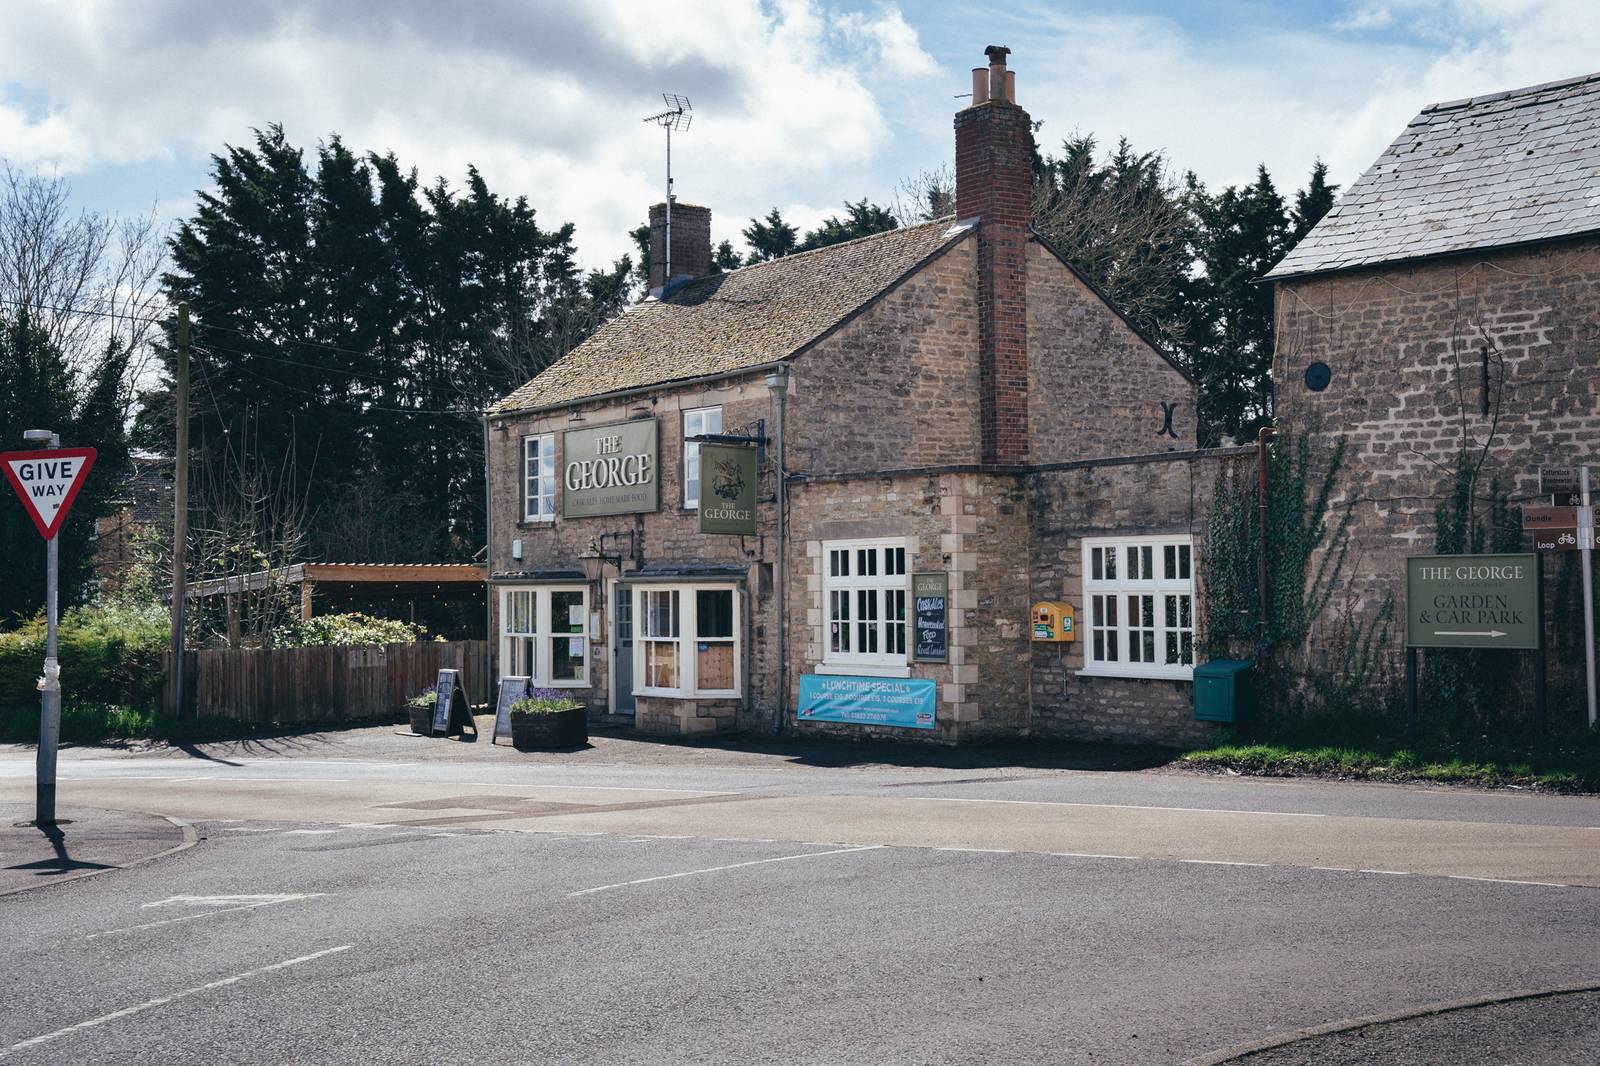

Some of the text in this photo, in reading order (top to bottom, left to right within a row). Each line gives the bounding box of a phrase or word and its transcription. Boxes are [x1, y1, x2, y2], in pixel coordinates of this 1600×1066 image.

[595, 435, 621, 454] THE
[20, 461, 73, 481] GIVE
[565, 454, 650, 491] GEORGE
[32, 484, 65, 497] WAY
[704, 508, 751, 520] GEORGE
[1537, 541, 1556, 550] Loop
[1420, 566, 1524, 580] THE GEORGE
[917, 583, 943, 591] GEORGE
[1434, 595, 1507, 609] GARDEN
[1420, 610, 1523, 624] & CAR PARK
[826, 680, 906, 693] LUNCHTIME SPECIAL
[887, 695, 913, 705] COURSES
